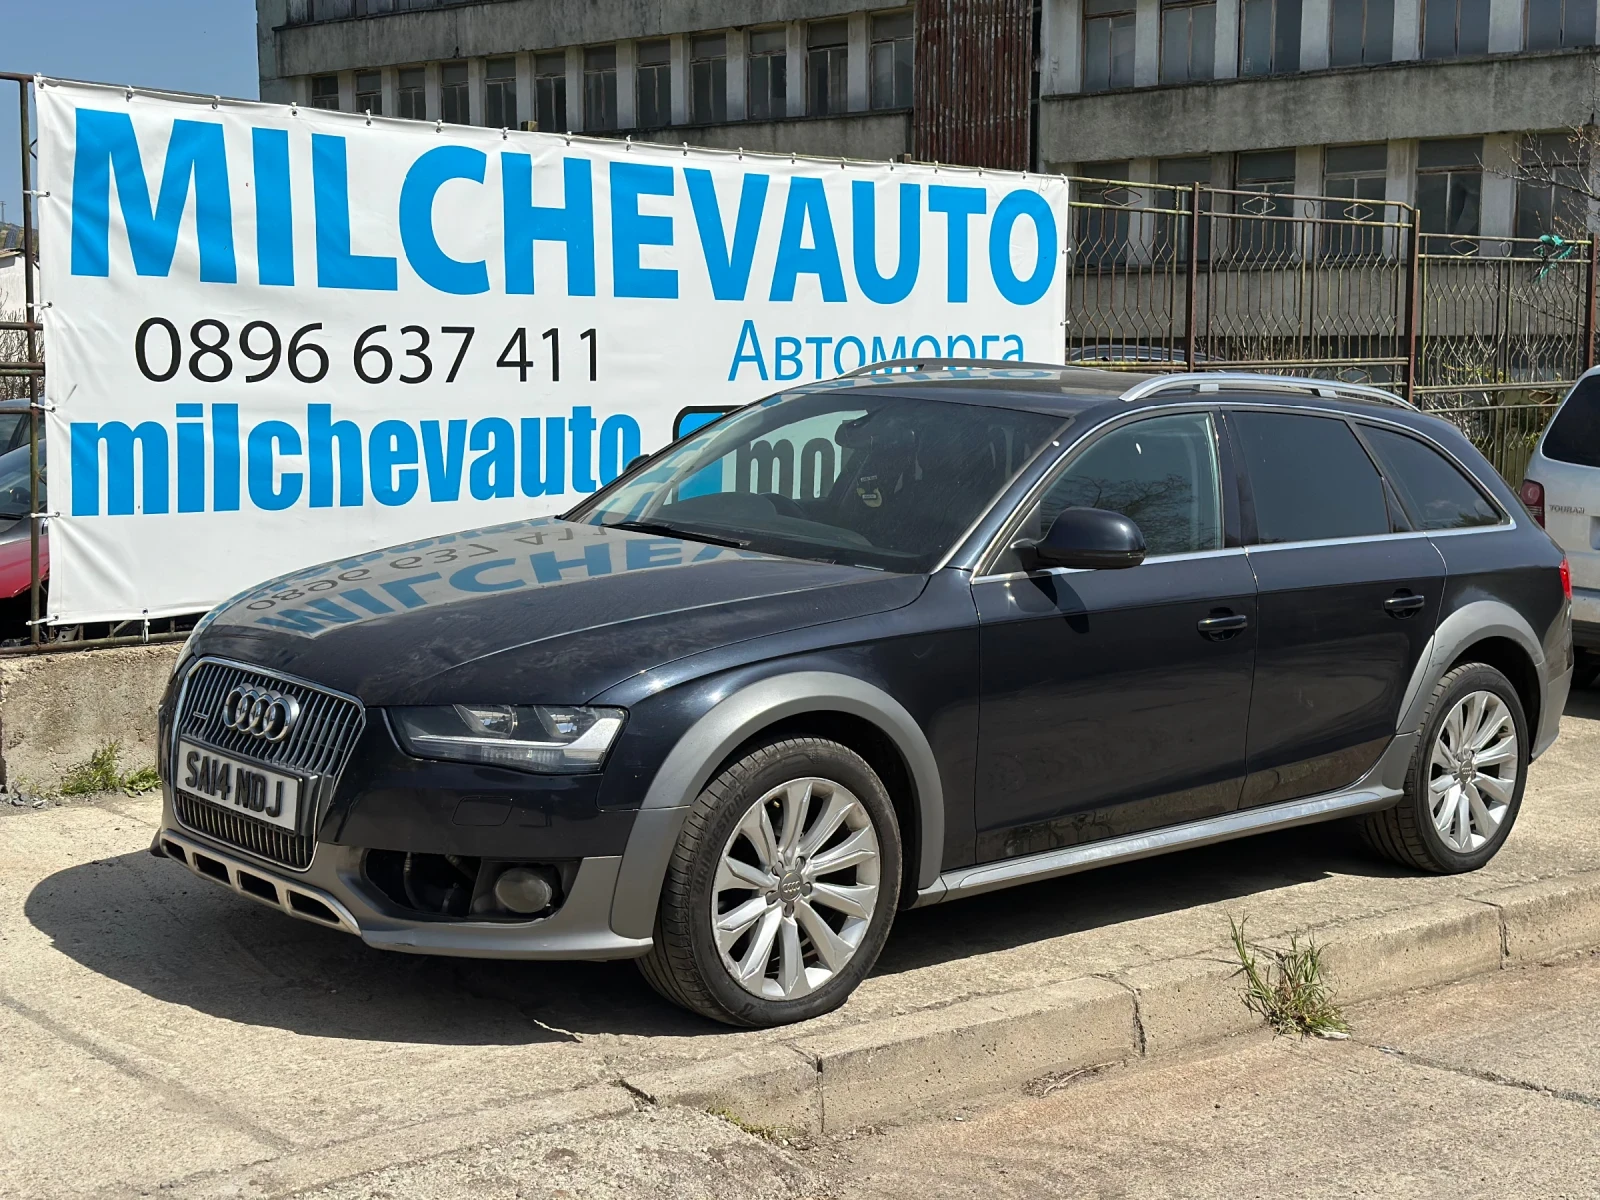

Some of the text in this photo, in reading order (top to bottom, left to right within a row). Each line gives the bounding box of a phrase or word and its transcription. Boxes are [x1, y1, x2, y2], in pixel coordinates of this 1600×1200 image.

[71, 108, 1057, 305] MILCHEVAUTO
[136, 318, 597, 384] 0896 637 411
[70, 402, 641, 517] milchevauto
[1549, 504, 1585, 514] TOURAN
[185, 751, 283, 818] SA14 NDJ
[693, 785, 751, 895] BRIDGESTONE
